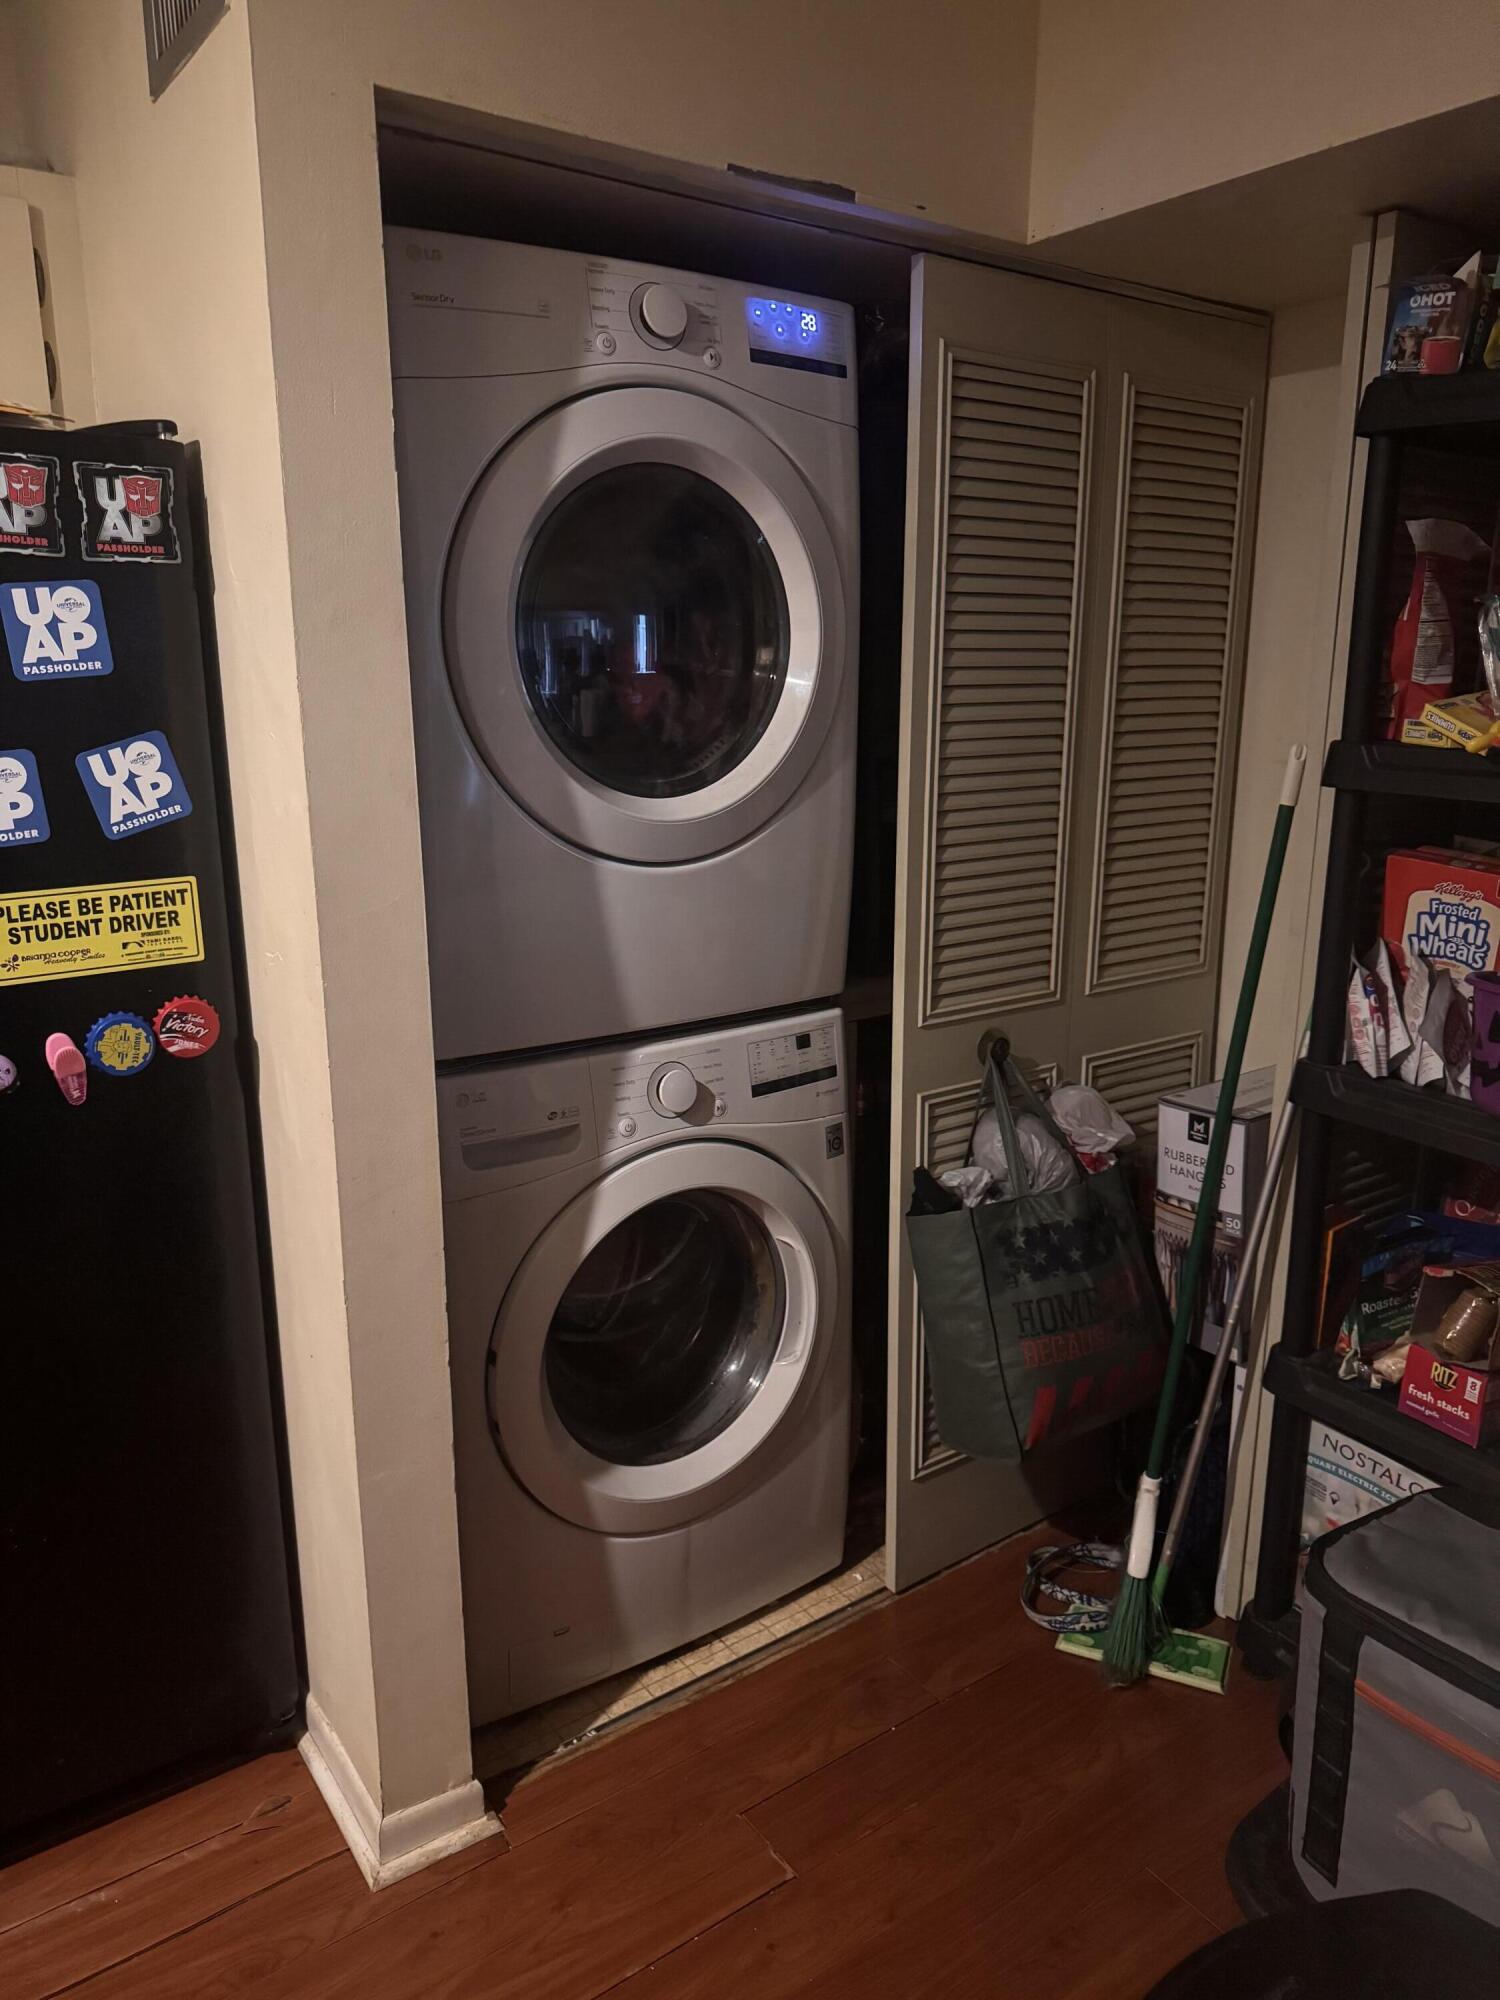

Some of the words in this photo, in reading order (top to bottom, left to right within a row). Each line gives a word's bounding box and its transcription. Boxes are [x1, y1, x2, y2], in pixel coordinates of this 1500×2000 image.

[801, 314, 816, 331] 28
[0, 534, 48, 547] HOLDER
[96, 543, 165, 554] PASSHOLDER
[23, 661, 103, 676] PASSHOLDER
[112, 804, 182, 834] PASSHOLDER
[0, 829, 39, 842] OLDER
[77, 897, 104, 916] BE
[109, 888, 188, 913] PATIENT
[1435, 882, 1484, 902] Kellogg's
[1431, 899, 1479, 921] Frosted
[8, 918, 102, 945] STUDENT
[109, 910, 181, 934] DRIVER
[1419, 913, 1488, 947] Mini
[1410, 935, 1487, 969] Wheats
[1164, 1147, 1234, 1175] RUBBERD
[1170, 1163, 1226, 1190] HANGS
[1226, 1217, 1241, 1230] 50
[1430, 1361, 1459, 1390] RITZ
[1408, 1384, 1434, 1404] fresh
[1437, 1400, 1470, 1420] stacks
[1308, 1455, 1338, 1473] QUART
[1338, 1467, 1380, 1494] ELECTRIC
